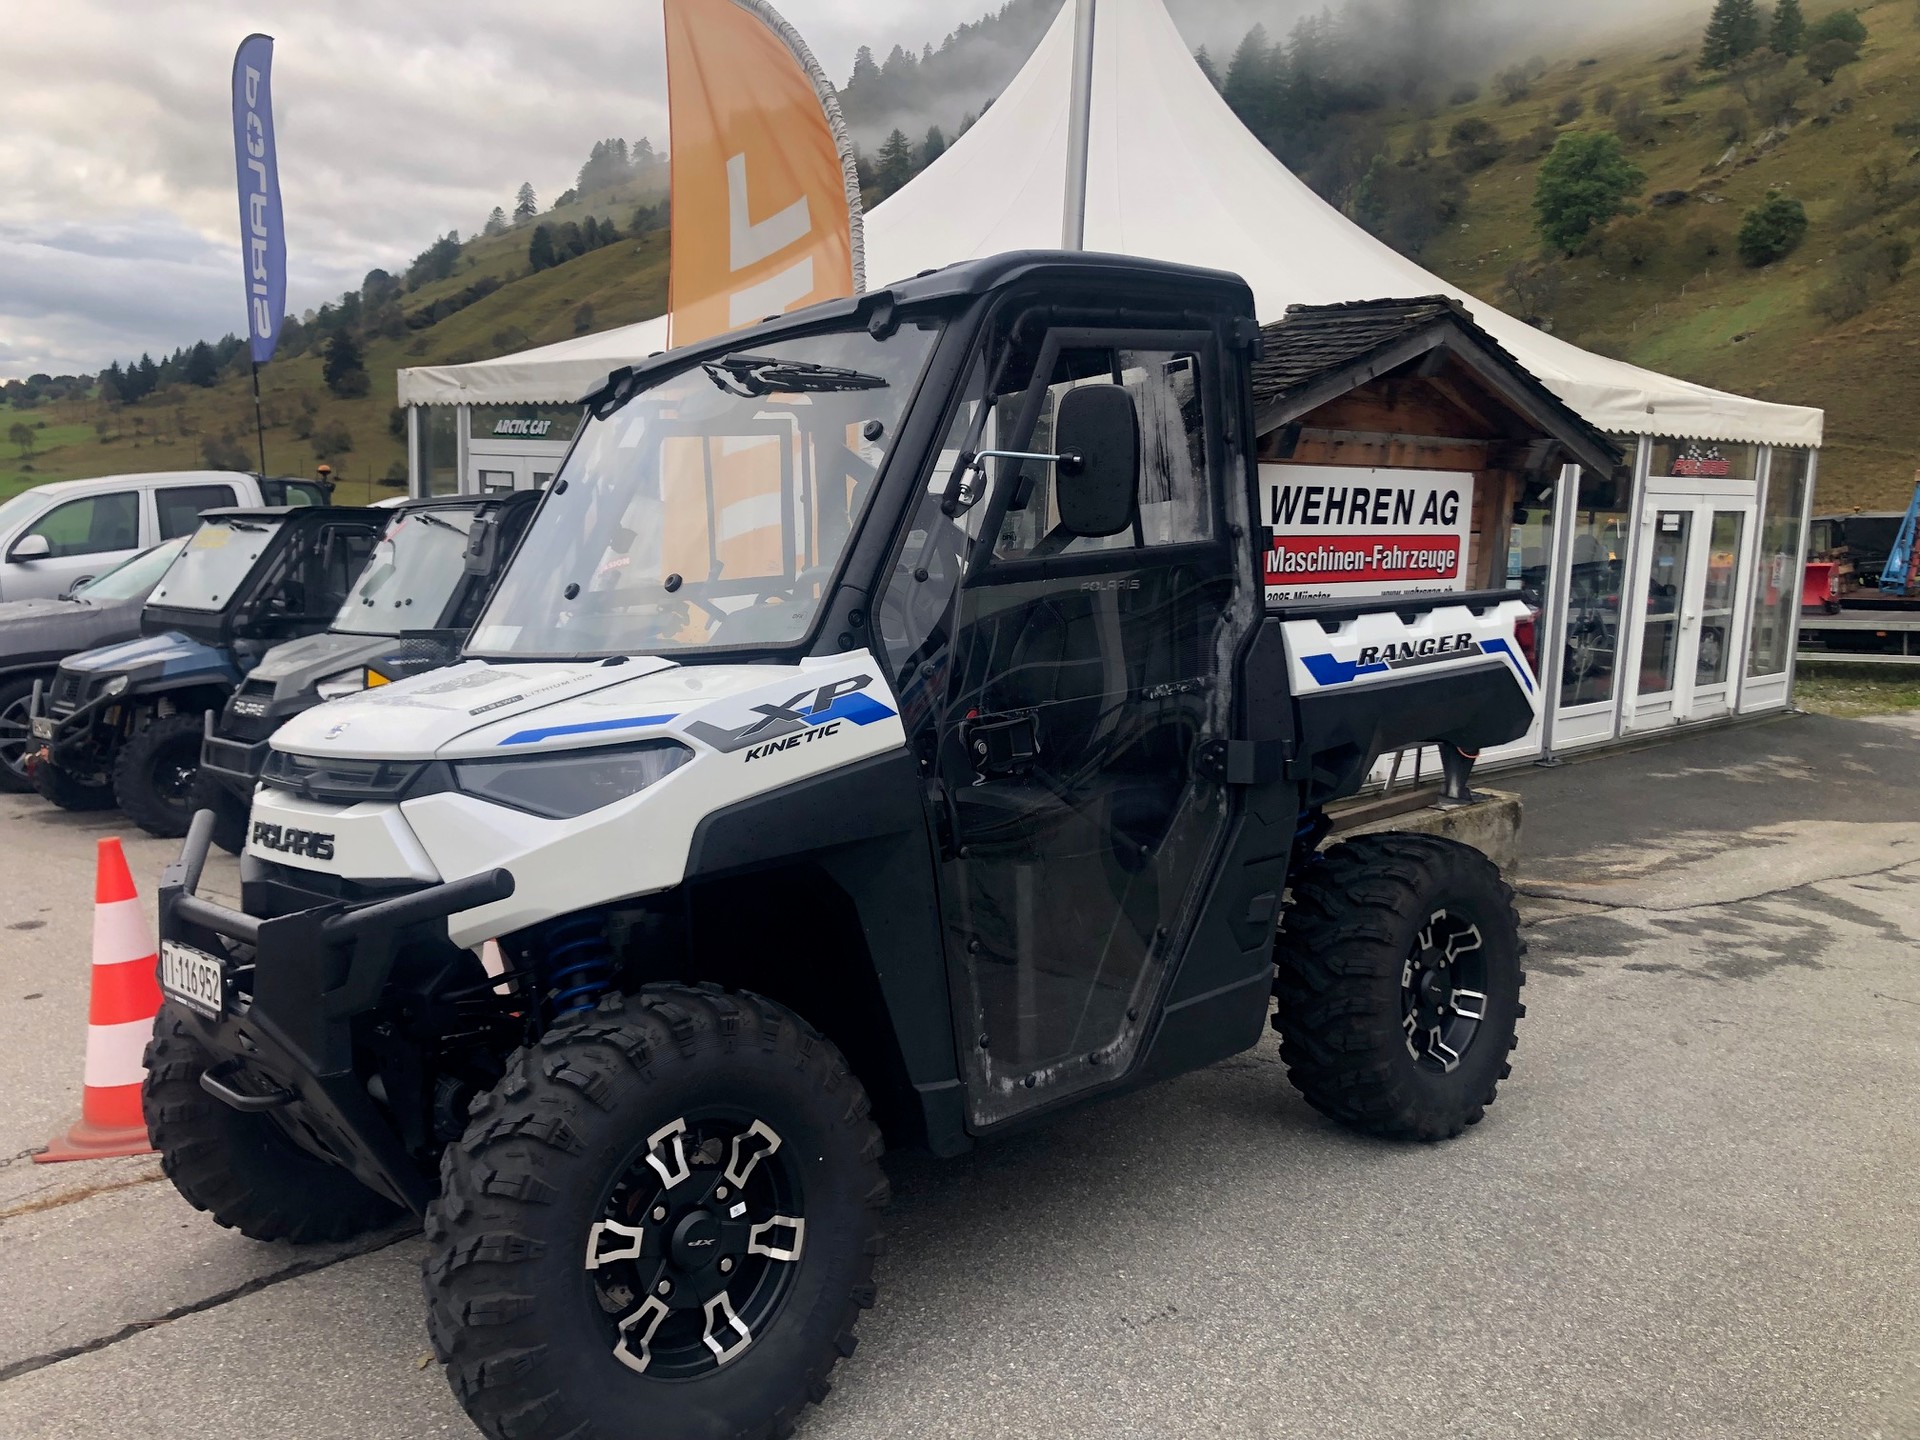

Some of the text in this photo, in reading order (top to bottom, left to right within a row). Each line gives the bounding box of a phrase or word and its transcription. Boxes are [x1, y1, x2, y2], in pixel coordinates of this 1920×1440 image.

[493, 419, 551, 435] ARCTIC CAT
[1271, 485, 1460, 526] WEHREN AG
[1266, 545, 1455, 574] Maschinen-Fahrzeuge
[1080, 579, 1140, 592] POLARIS
[1356, 632, 1473, 666] RANGER
[737, 674, 874, 739] XP
[744, 722, 841, 763] KINETIC
[252, 821, 335, 860] POLARIS
